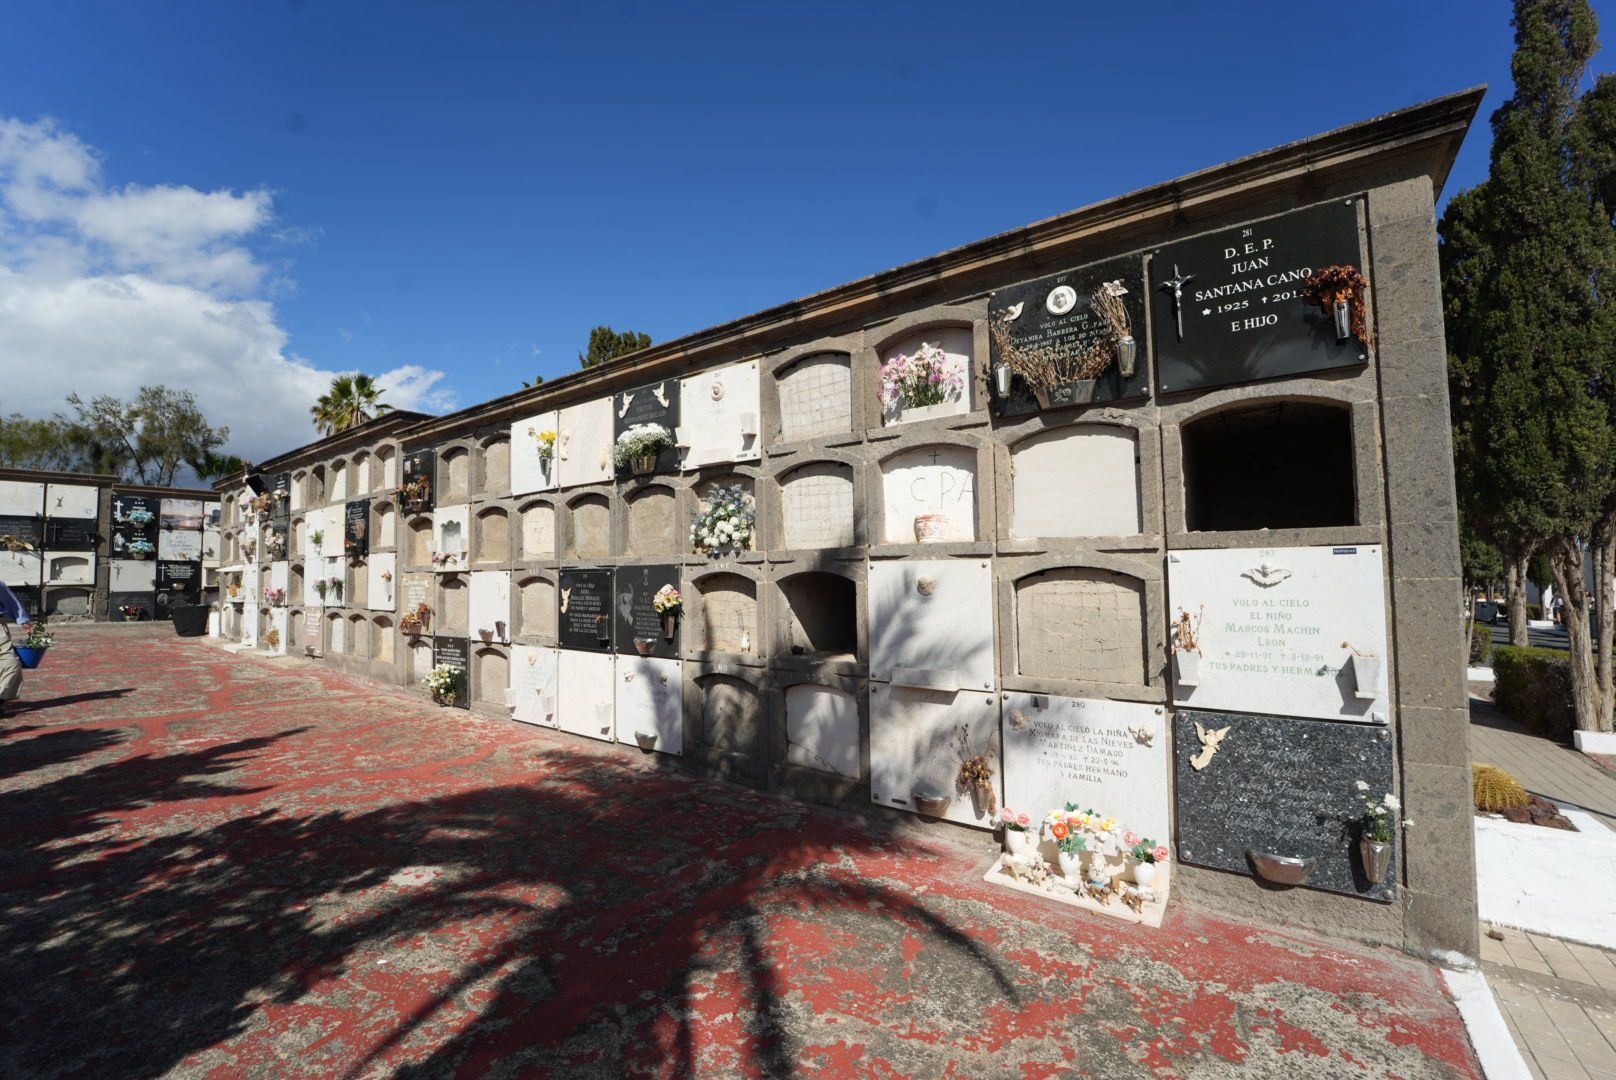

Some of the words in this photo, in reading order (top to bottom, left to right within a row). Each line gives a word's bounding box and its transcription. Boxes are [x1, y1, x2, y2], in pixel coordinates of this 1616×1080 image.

[1242, 228, 1253, 238] 281
[1231, 255, 1269, 275] JUAN
[1195, 278, 1265, 302] SANTANA
[1267, 267, 1312, 286] CANO
[1217, 299, 1250, 314] 1925
[1272, 289, 1306, 303] 201
[1231, 320, 1241, 332] E
[1244, 313, 1278, 330] HIJO
[1046, 325, 1078, 338] BARRERA
[1232, 599, 1258, 607] VOLO
[1262, 599, 1276, 607] AL
[1279, 599, 1310, 608] CIELO
[1250, 611, 1262, 620] EL
[1266, 611, 1292, 621] NIÑO
[1225, 622, 1270, 634] MARCOS
[1209, 661, 1228, 671] TUS
[1230, 663, 1269, 674] PADRES
[1271, 664, 1279, 674] Y
[1101, 737, 1133, 749] NIEVES
